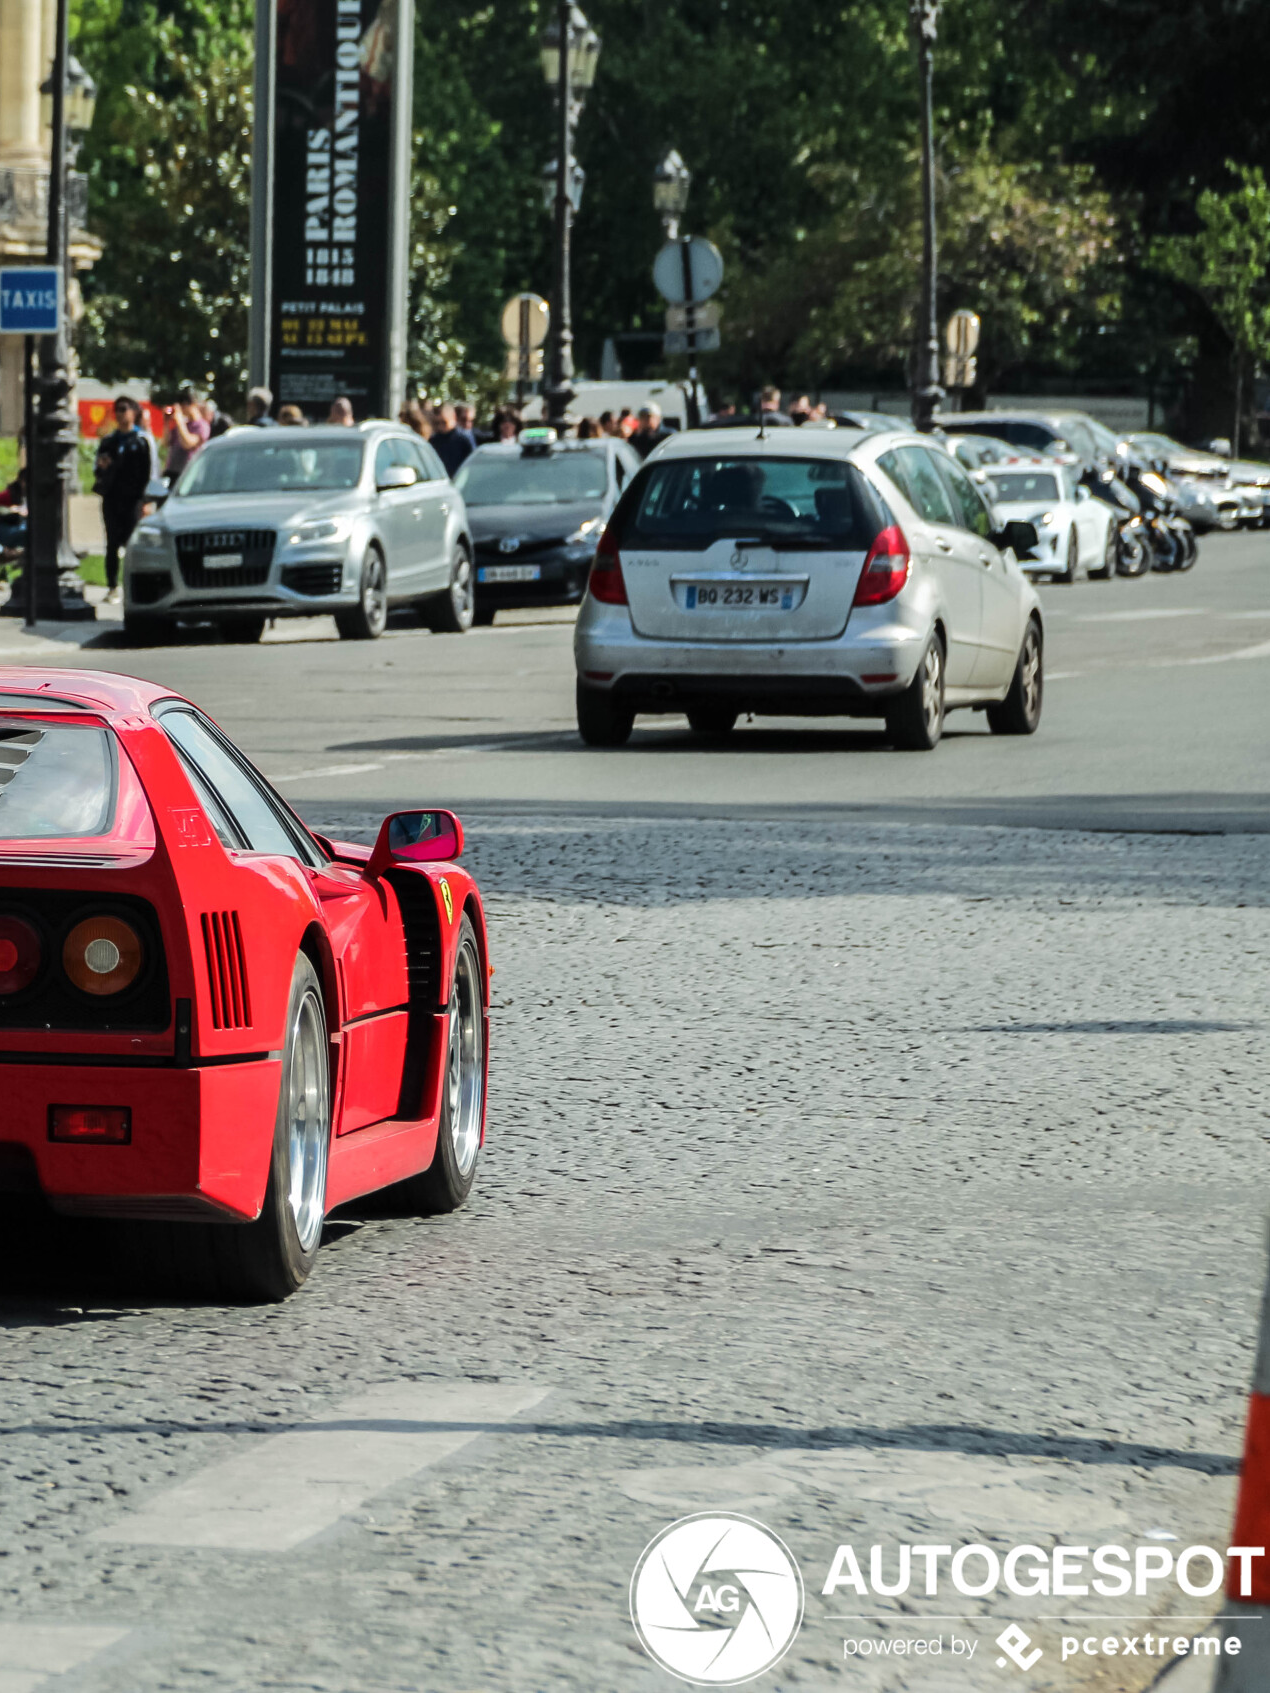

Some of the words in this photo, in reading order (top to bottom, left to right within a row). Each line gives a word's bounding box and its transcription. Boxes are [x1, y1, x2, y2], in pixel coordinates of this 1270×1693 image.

[305, 128, 331, 241] PARIS
[306, 248, 354, 265] 1815
[306, 268, 354, 286] 1848
[2, 289, 56, 310] TAXIS
[281, 302, 317, 314] PETIT
[319, 302, 365, 315] PALAIS
